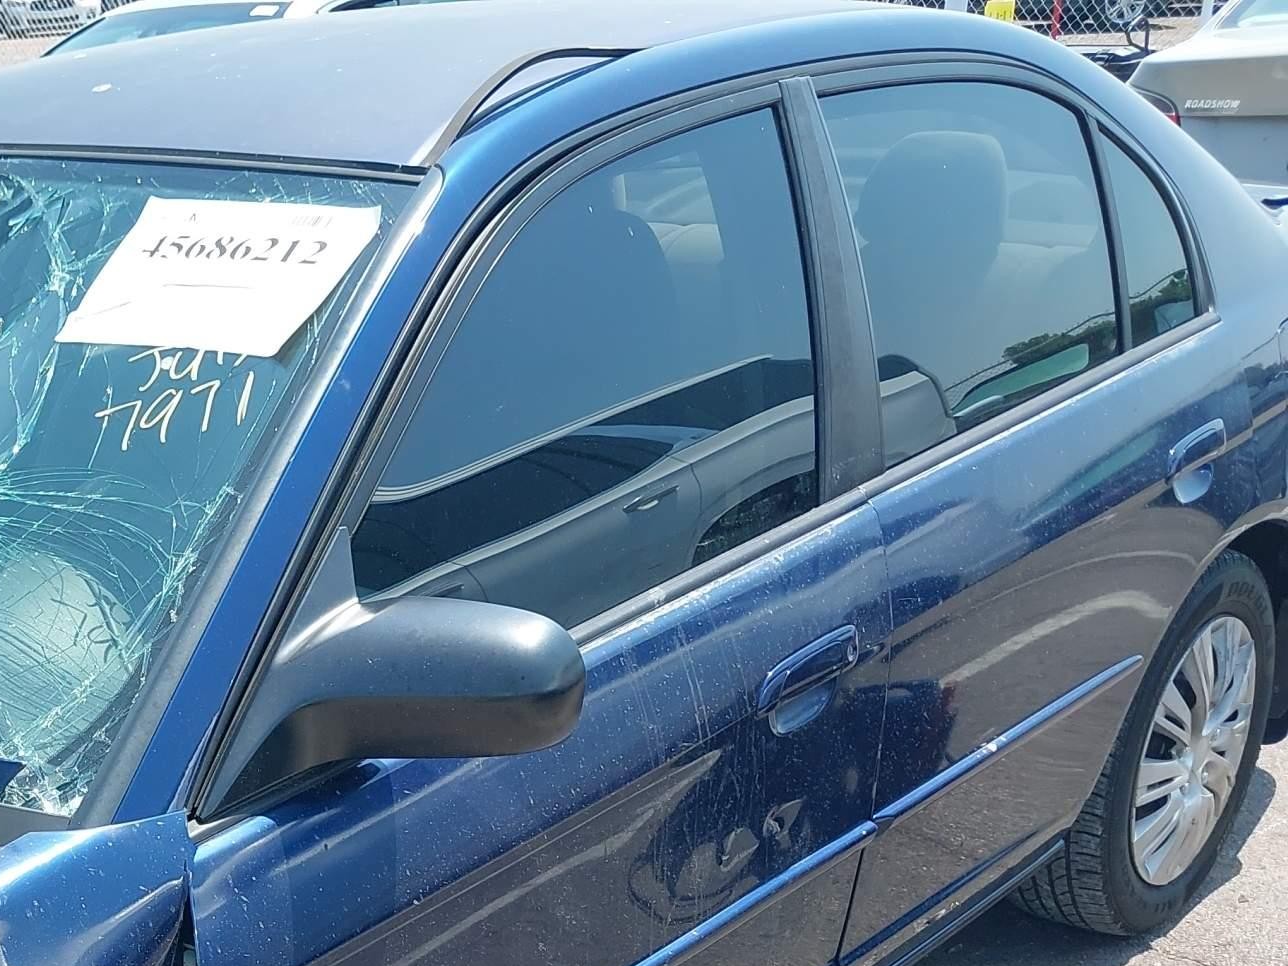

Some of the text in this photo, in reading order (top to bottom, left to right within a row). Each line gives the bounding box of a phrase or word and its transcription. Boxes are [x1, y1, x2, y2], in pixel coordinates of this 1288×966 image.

[1184, 99, 1241, 109] ROADSHOW
[142, 235, 328, 265] 45686212
[94, 371, 255, 451] 7971
